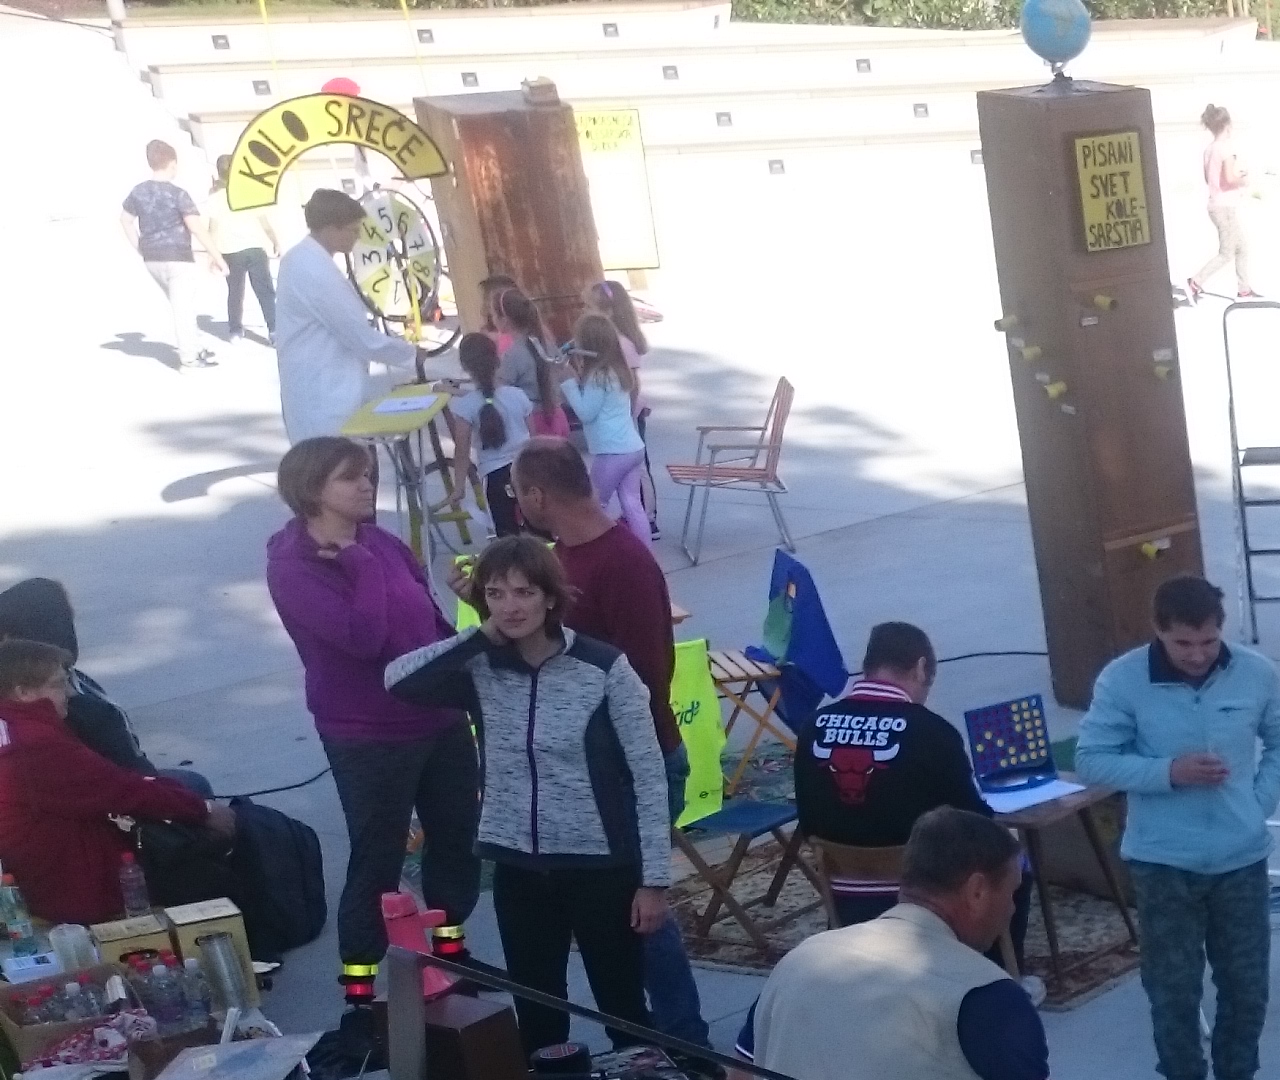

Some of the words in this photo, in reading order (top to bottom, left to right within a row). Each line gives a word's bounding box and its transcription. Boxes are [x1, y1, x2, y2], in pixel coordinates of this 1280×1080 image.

[238, 110, 309, 188] KOLO
[325, 100, 425, 166] SREČE
[1082, 136, 1133, 169] PISANI
[1090, 171, 1130, 199] SVET
[378, 207, 393, 233] 5
[1105, 197, 1145, 220] KOLE-
[362, 222, 384, 242] 4
[397, 211, 409, 235] 6
[1089, 218, 1145, 248] SARSTVA
[409, 234, 425, 251] 7
[362, 250, 382, 265] 3
[412, 260, 430, 277] 8
[372, 269, 390, 293] 2
[393, 280, 401, 305] 1
[815, 714, 907, 732] CHICAGO
[823, 728, 889, 747] BULLS
